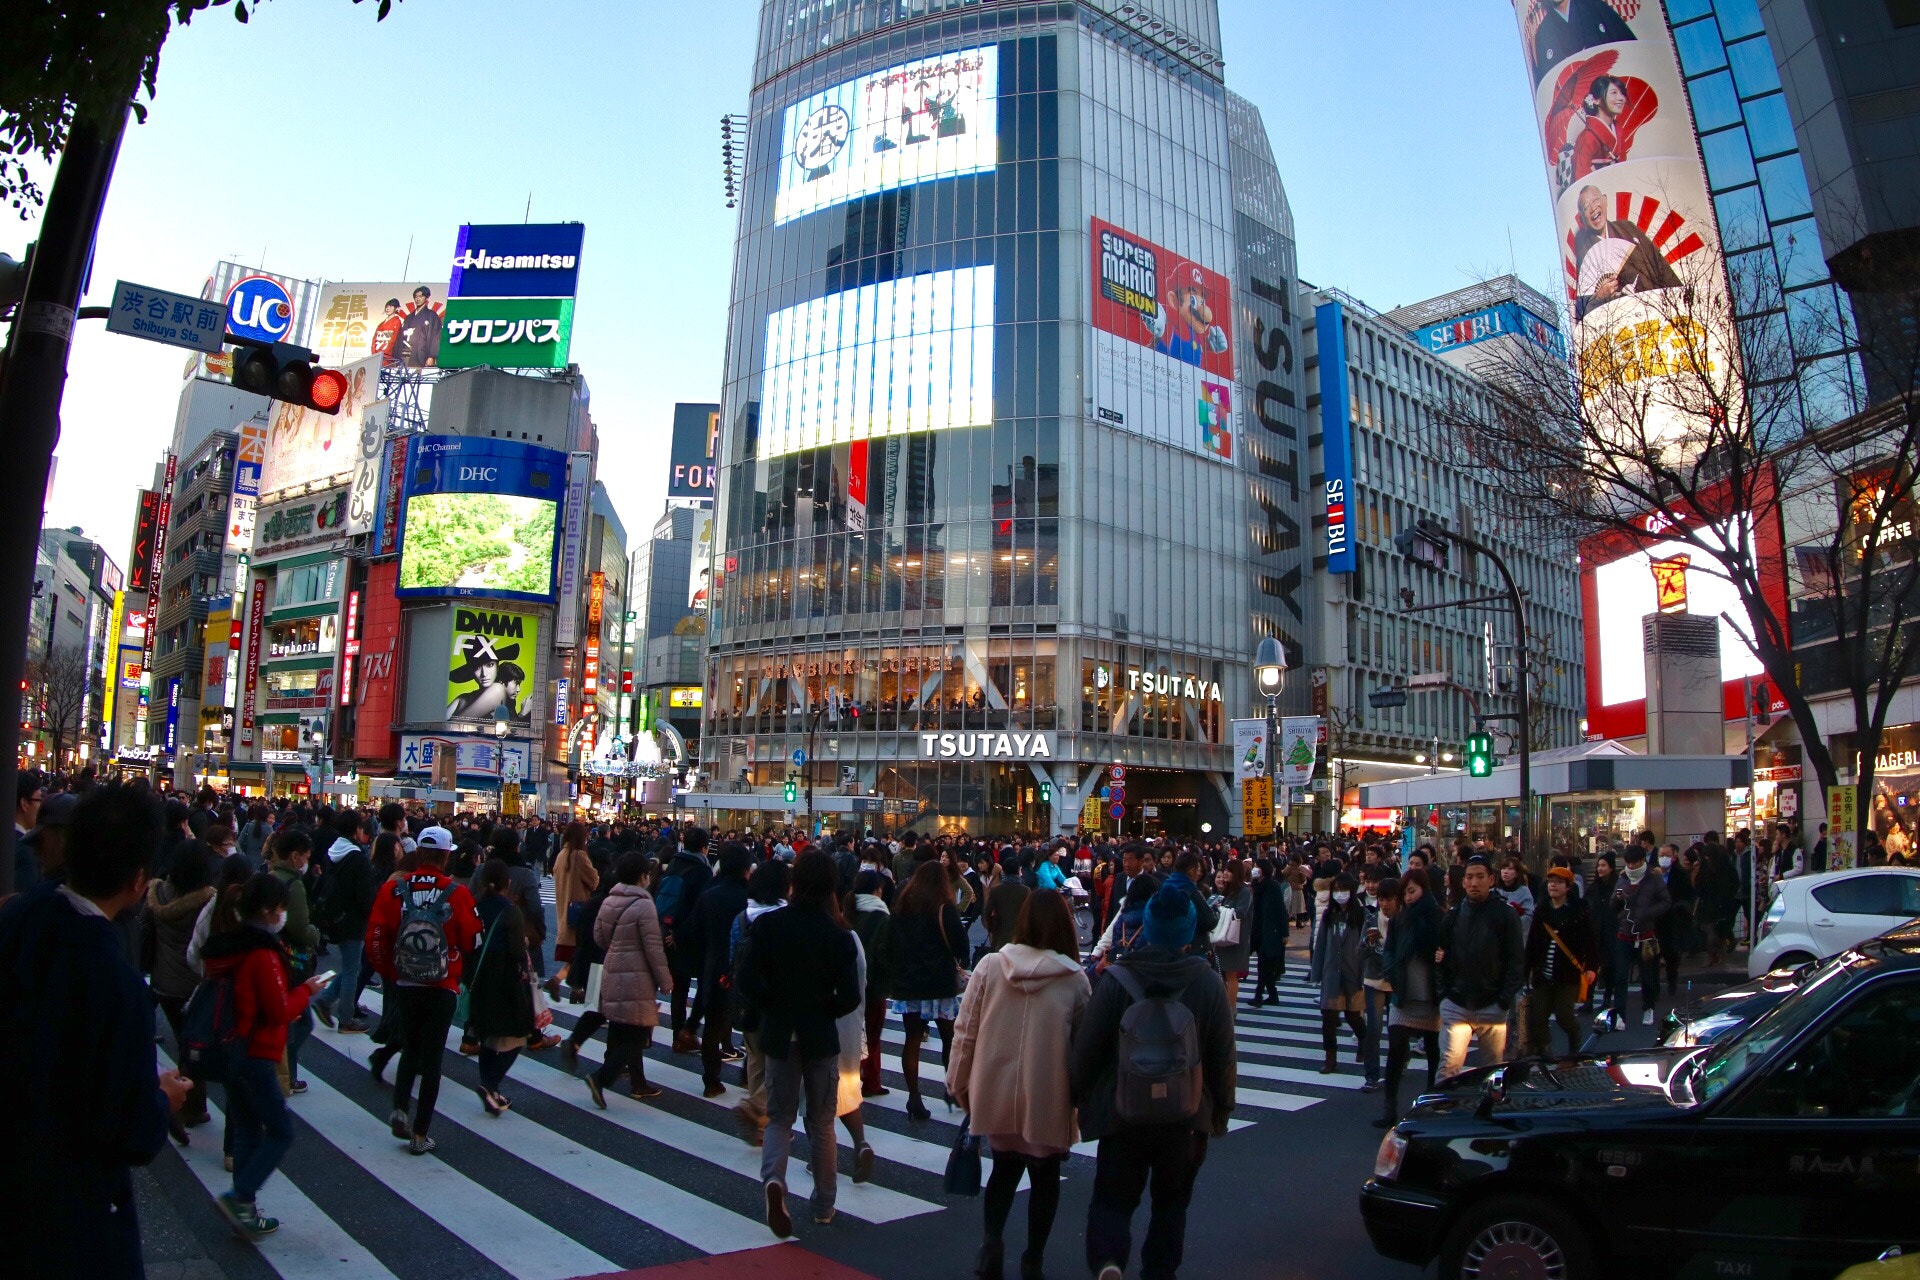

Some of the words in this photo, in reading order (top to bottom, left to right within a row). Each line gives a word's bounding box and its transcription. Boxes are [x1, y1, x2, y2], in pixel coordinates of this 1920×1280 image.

[454, 249, 576, 269] Hisamitsu
[1102, 233, 1154, 270] SUPER
[1102, 252, 1155, 298] MARIO
[121, 290, 219, 331] 渋谷駅前
[232, 290, 287, 334] UC
[1126, 289, 1155, 315] RUN
[132, 318, 177, 338] Shibuya
[180, 326, 202, 343] Sta.
[318, 321, 367, 347] 記念
[447, 319, 561, 343] サロンパス
[1430, 311, 1501, 351] SEIBU
[1098, 343, 1120, 358] iTunes
[417, 444, 431, 454] DHC
[433, 442, 461, 452] Channel
[351, 414, 383, 529] もんじゃ
[459, 467, 497, 482] DHC
[1326, 478, 1346, 556] SEIBU
[563, 545, 577, 595] neon
[460, 588, 474, 596] DHC
[456, 609, 524, 638] DMM
[271, 641, 317, 657] Euphoria
[453, 634, 499, 660] FX
[585, 647, 598, 688] 三千
[1128, 669, 1222, 702] TSUTAYA
[1771, 700, 1784, 711] pdc
[1288, 727, 1312, 735] SHIBUYA
[922, 733, 1050, 757] TSUTAYA
[411, 874, 417, 882] I
[417, 875, 436, 884] AM
[258, 1218, 267, 1228] N
[1715, 1260, 1752, 1275] TAXI
